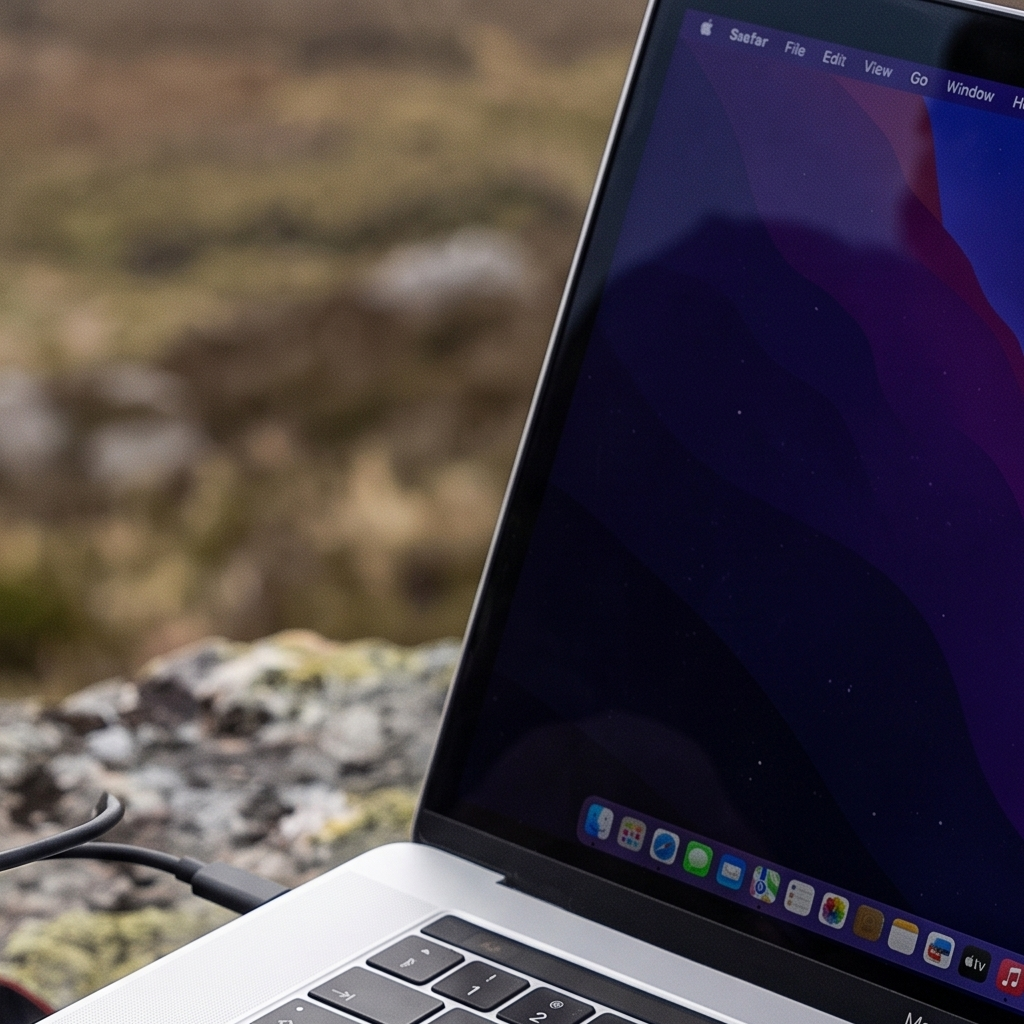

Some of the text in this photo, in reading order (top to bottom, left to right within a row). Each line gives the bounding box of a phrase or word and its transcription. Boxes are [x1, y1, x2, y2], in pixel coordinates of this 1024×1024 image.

[784, 41, 806, 57] File
[822, 50, 847, 67] Edit
[864, 59, 893, 77] View
[910, 71, 928, 86] Go
[947, 79, 995, 103] Window
[467, 985, 481, 996] 1
[528, 1011, 548, 1024] 2
